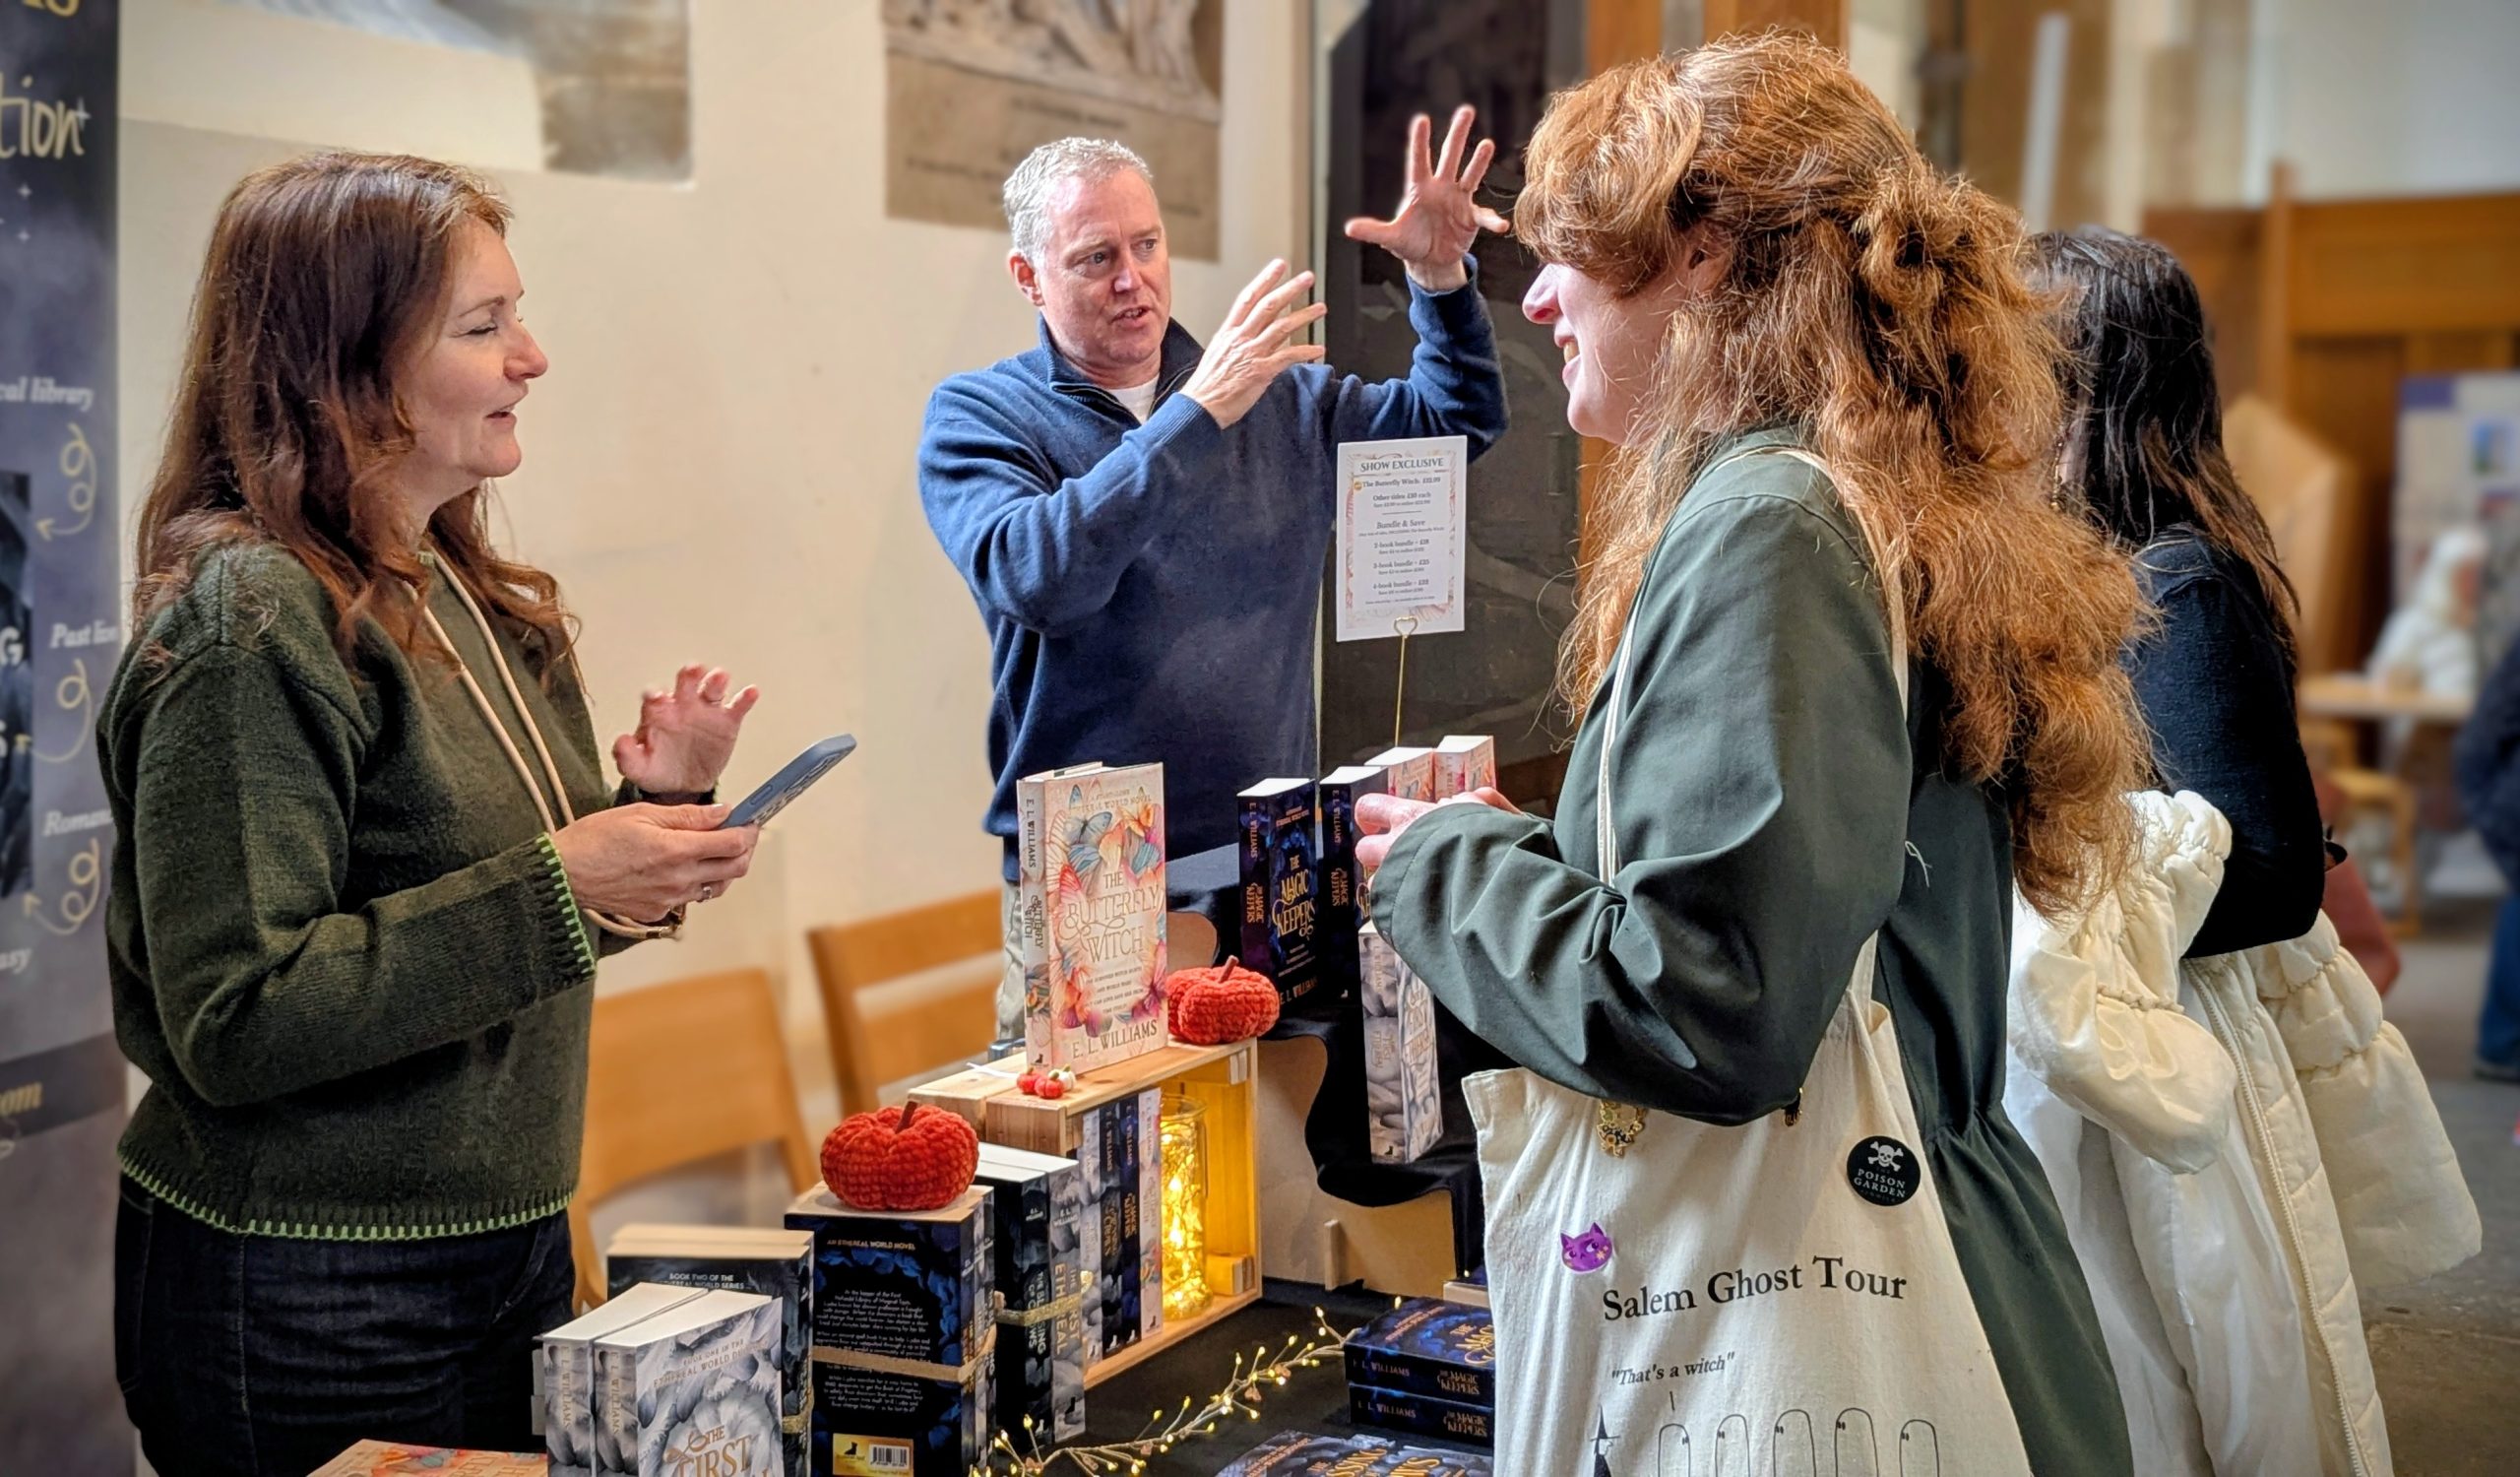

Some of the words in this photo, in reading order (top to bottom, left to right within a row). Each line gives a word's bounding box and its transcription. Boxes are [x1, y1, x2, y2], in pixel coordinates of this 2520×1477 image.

[1360, 460, 1390, 473] SHOW
[1392, 457, 1444, 470] EXCLUSIVE
[1377, 521, 1401, 530] Bundle
[50, 622, 92, 649] Past
[1027, 820, 1036, 867] WILLIAMS
[1249, 819, 1258, 860] WILLIAMS
[1102, 871, 1123, 889] THE
[1281, 868, 1309, 903] MAGIC
[1066, 884, 1160, 926] BUTTERFLY
[1273, 898, 1315, 938] KEEPERS
[1086, 926, 1144, 963] WITCH
[1286, 990, 1292, 1002] L
[1073, 1041, 1084, 1059] E.
[1088, 1038, 1099, 1055] L.
[1101, 1019, 1158, 1051] WILLIAMS
[1854, 1177, 1906, 1198] GARDEN
[1858, 1168, 1906, 1188] POISON
[838, 1239, 869, 1248] ETHEREAL
[894, 1243, 916, 1252] NOVEL
[1069, 1268, 1078, 1290] THE
[1603, 1285, 1697, 1321] Salem
[1707, 1264, 1803, 1305] Ghost
[1812, 1254, 1907, 1300] Tour
[701, 1354, 730, 1372] WORLD
[1369, 1362, 1411, 1378] WILLIAMS
[1450, 1371, 1479, 1385] MAGIC
[1670, 1368, 1679, 1379] a
[1685, 1352, 1735, 1377] witch"
[562, 1373, 571, 1429] WILLIAMS
[611, 1379, 621, 1436] WILLIAMS
[1375, 1402, 1417, 1419] WILLIAMS
[1457, 1412, 1486, 1426] MAGIC
[706, 1425, 725, 1445] THE
[675, 1434, 760, 1477] FIRST
